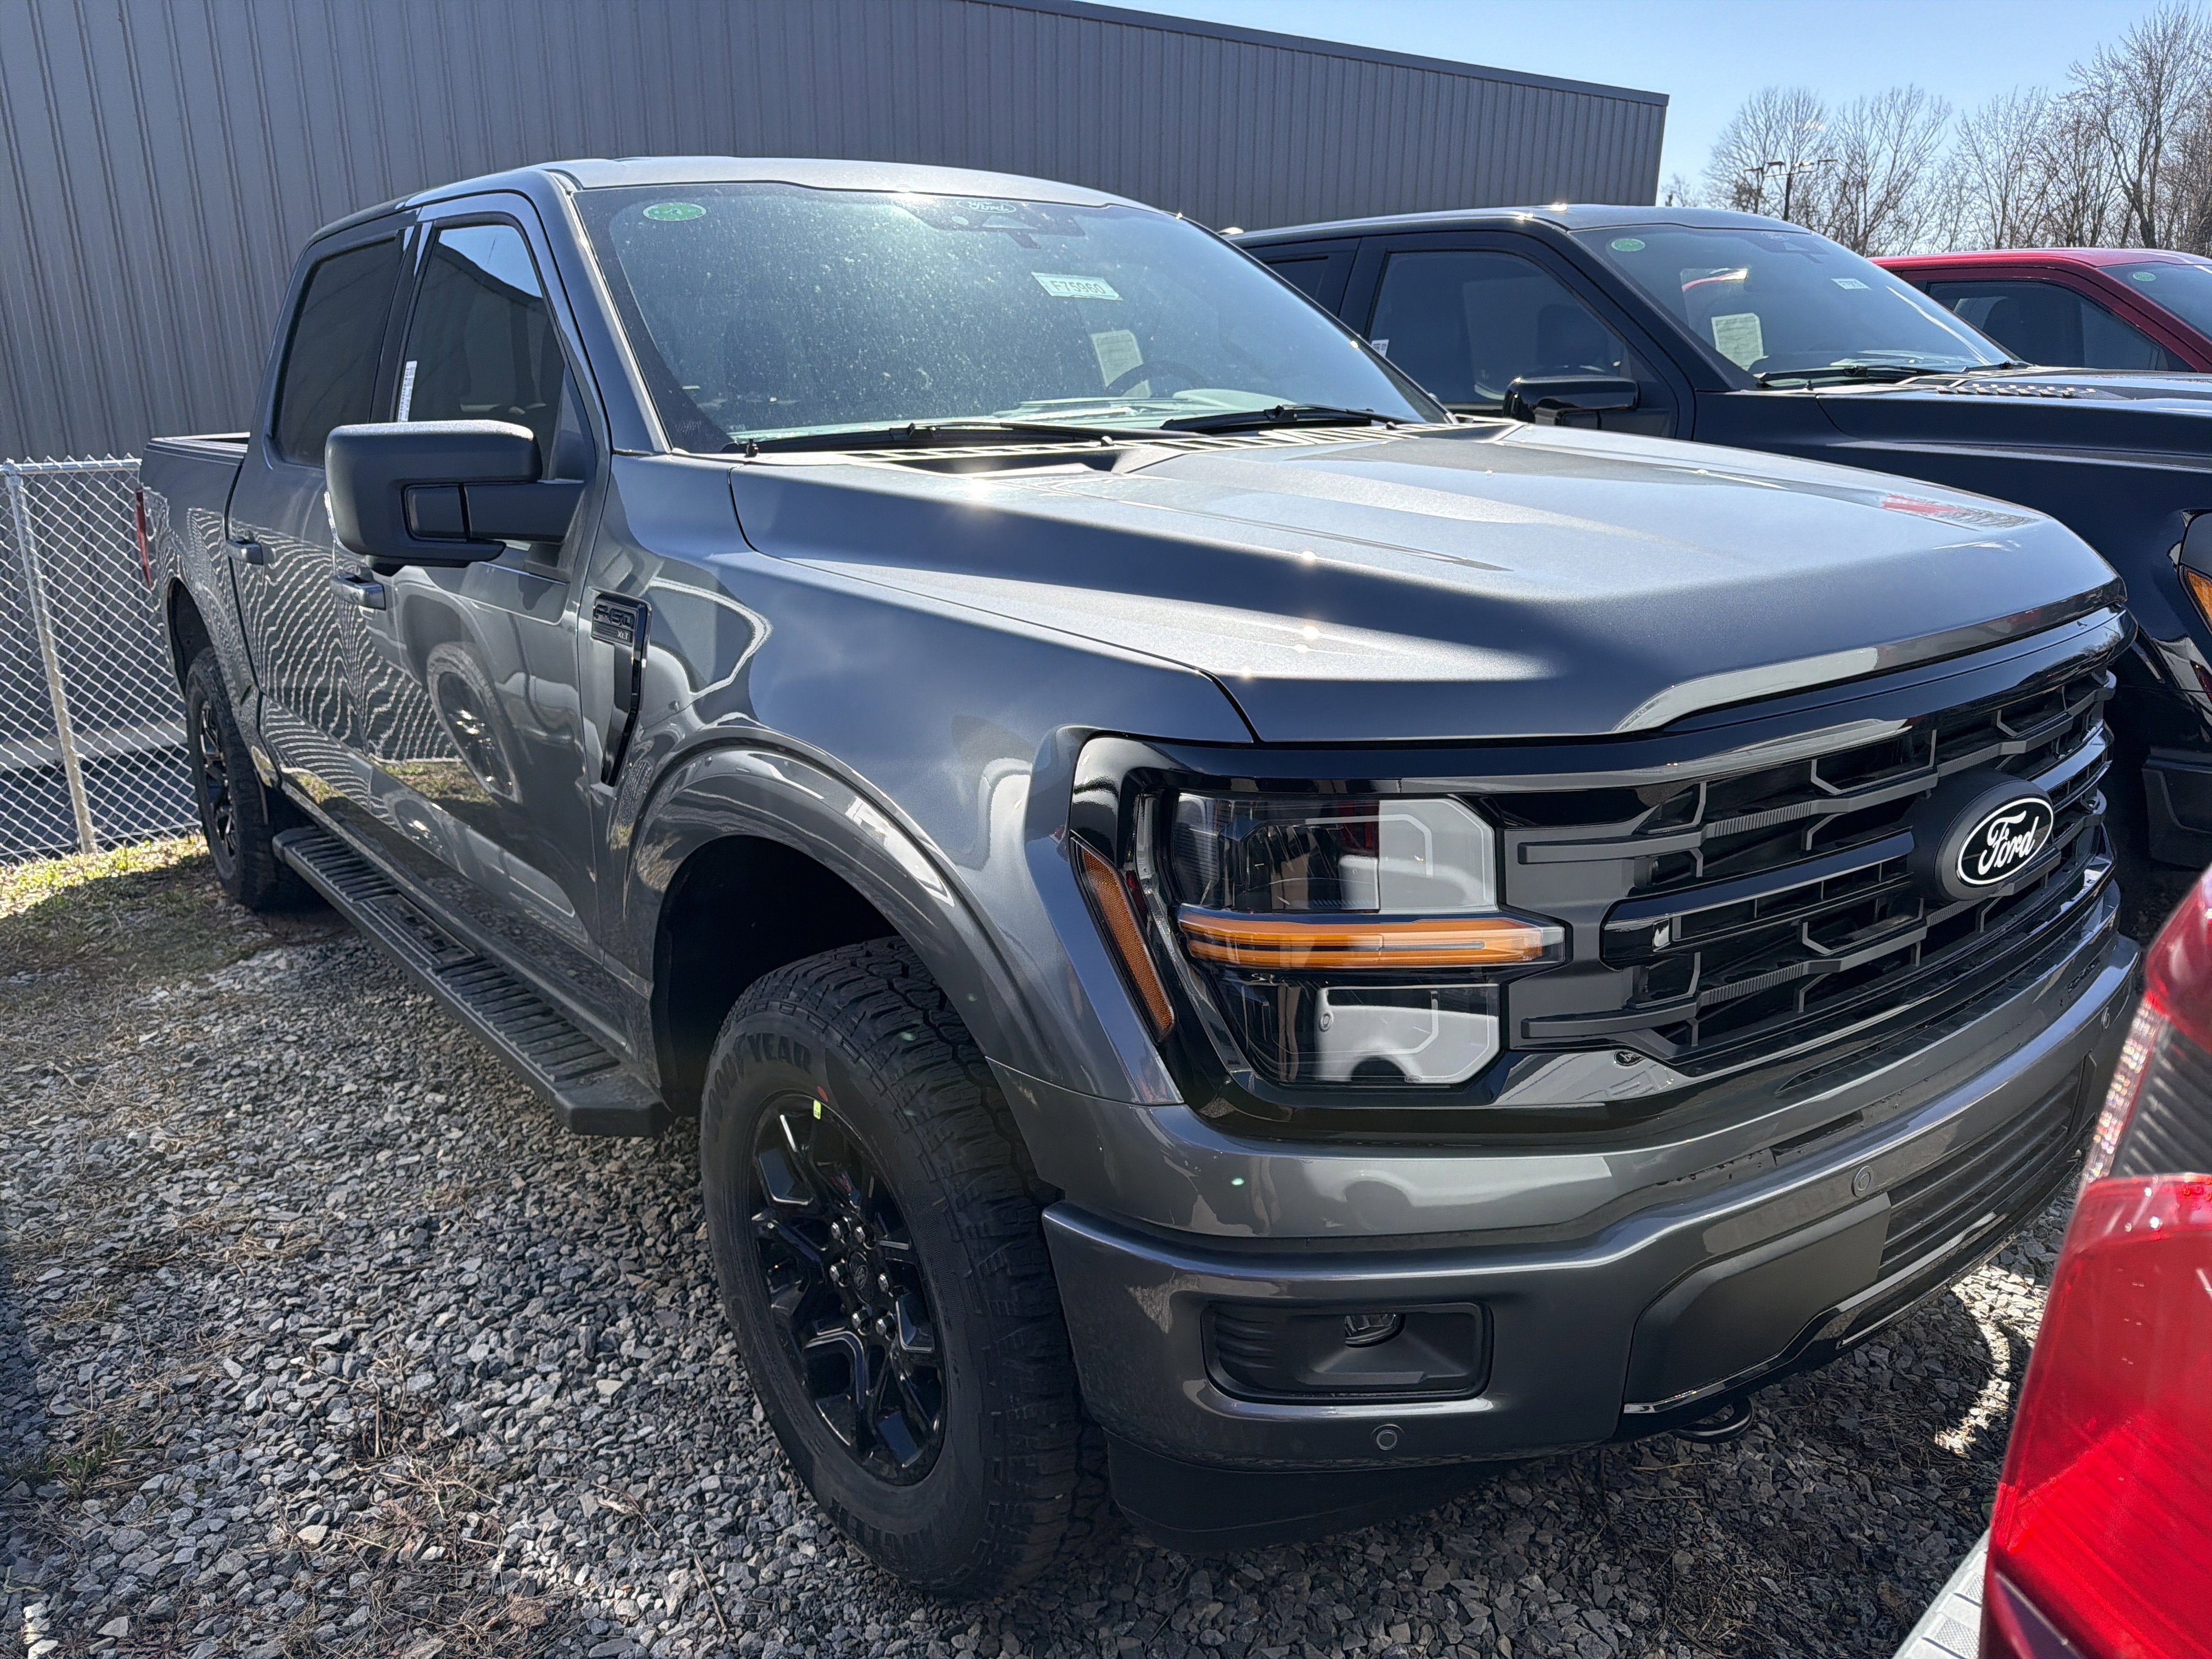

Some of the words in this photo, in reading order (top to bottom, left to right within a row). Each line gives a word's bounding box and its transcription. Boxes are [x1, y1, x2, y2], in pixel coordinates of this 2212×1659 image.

[968, 200, 1009, 211] Ford
[1049, 280, 1106, 294] F75960
[617, 630, 629, 640] XLT
[1978, 810, 2040, 876] Ford
